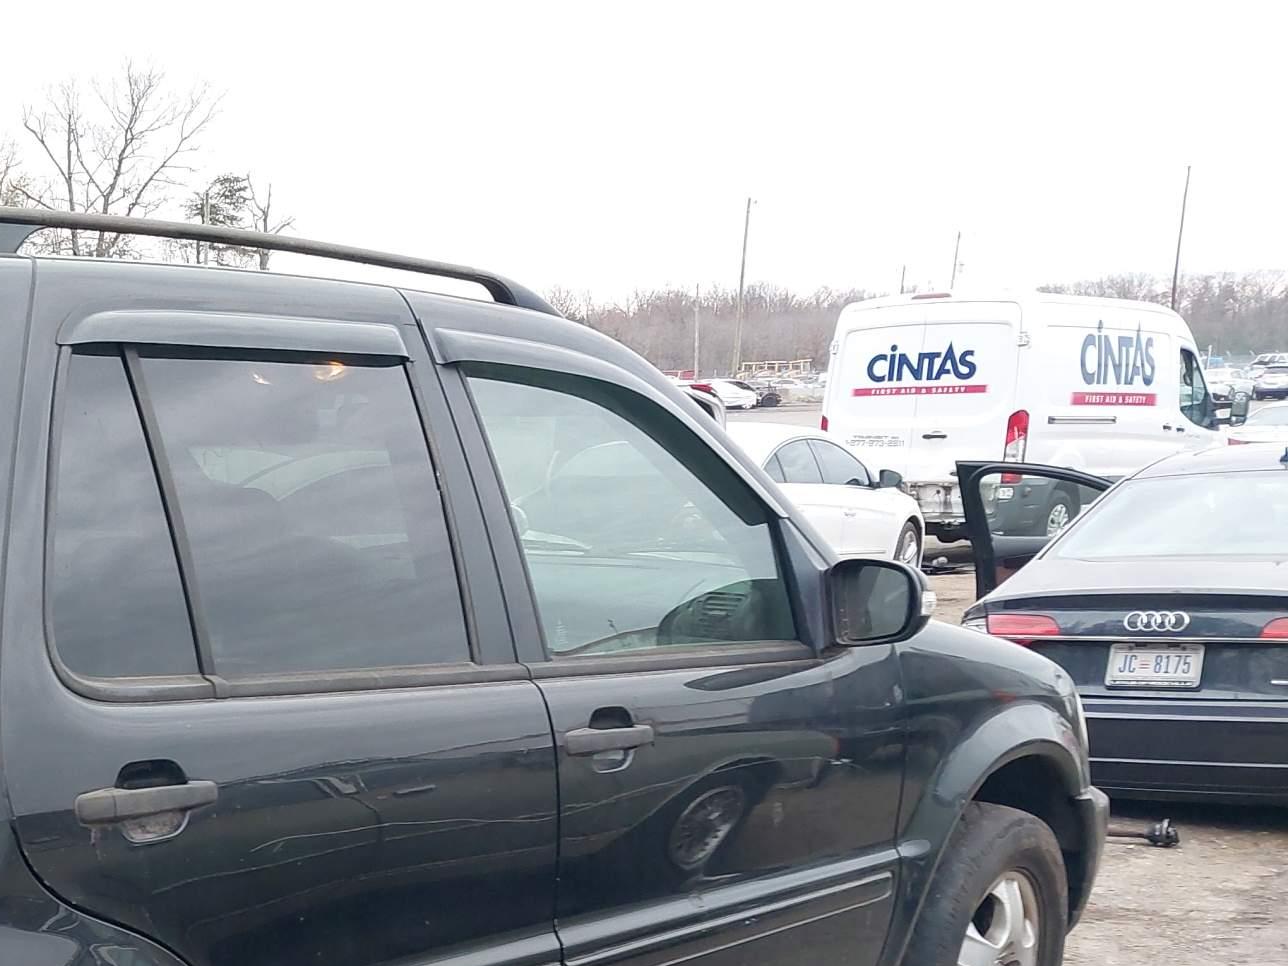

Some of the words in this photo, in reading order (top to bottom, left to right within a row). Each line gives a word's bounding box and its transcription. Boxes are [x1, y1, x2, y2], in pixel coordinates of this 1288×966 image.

[871, 388, 896, 396] FIRST
[900, 387, 916, 395] AID
[932, 386, 966, 394] SAFETY
[1084, 395, 1104, 403] FIRST
[1105, 395, 1117, 403] AID
[1125, 395, 1147, 404] SAFETY
[1118, 655, 1138, 673] JC
[1153, 655, 1193, 674] 8175
